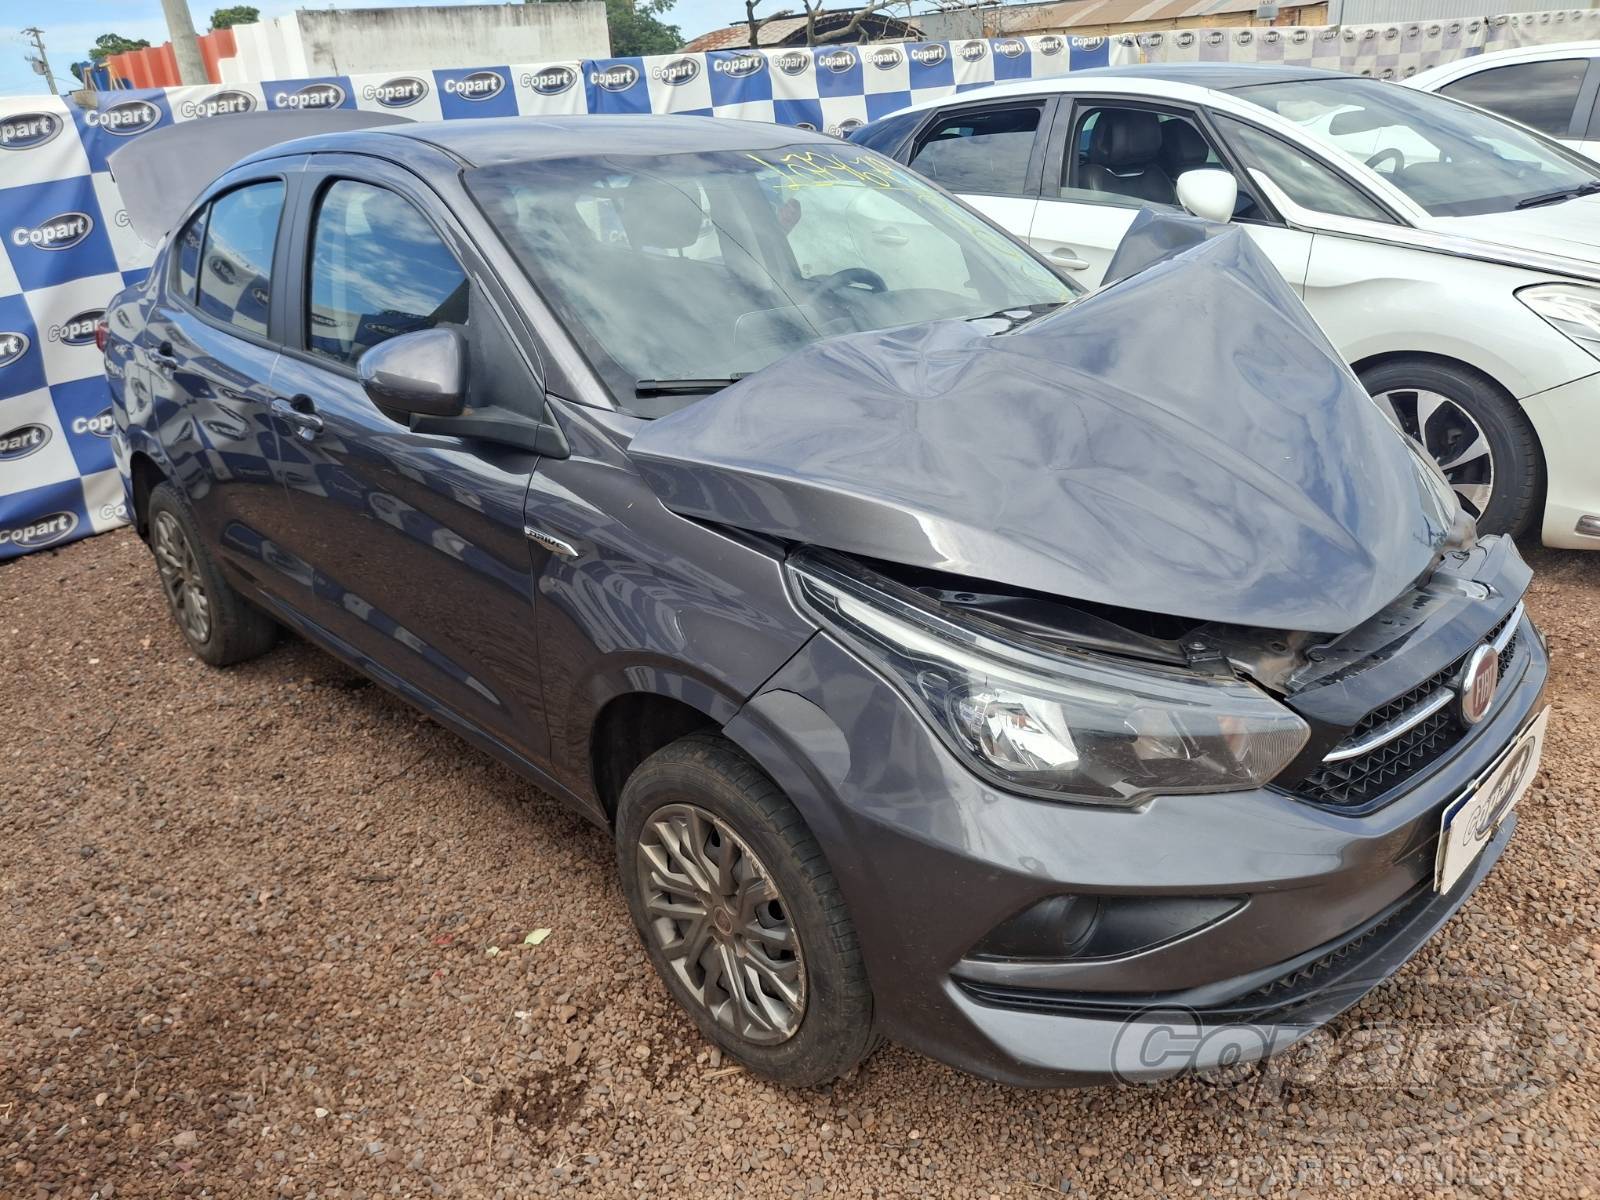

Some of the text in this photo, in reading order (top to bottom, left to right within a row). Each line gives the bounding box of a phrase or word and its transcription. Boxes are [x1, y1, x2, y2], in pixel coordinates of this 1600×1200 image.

[956, 45, 983, 58] Copart
[994, 43, 1022, 55] Copart
[1032, 41, 1060, 52] Copart
[1071, 37, 1100, 48] Copart
[714, 57, 760, 75] Copart
[772, 54, 806, 70] Copart
[818, 55, 851, 69] Copart
[865, 53, 898, 67] Copart
[911, 50, 942, 65] Copart
[521, 72, 569, 90] Copart
[590, 70, 632, 87] Copart
[652, 62, 693, 82] Copart
[363, 82, 419, 101] Copart
[444, 77, 497, 94] Copart
[181, 97, 246, 118] Copart
[275, 92, 337, 109] Copart
[84, 107, 151, 128] Copart
[0, 117, 50, 142] part
[13, 219, 84, 244] Copart
[48, 320, 99, 342] Copar
[73, 415, 112, 433] Cop
[0, 428, 40, 451] part
[0, 515, 68, 544] Copart
[529, 530, 564, 549] DRIVE
[1475, 668, 1494, 704] FIAT
